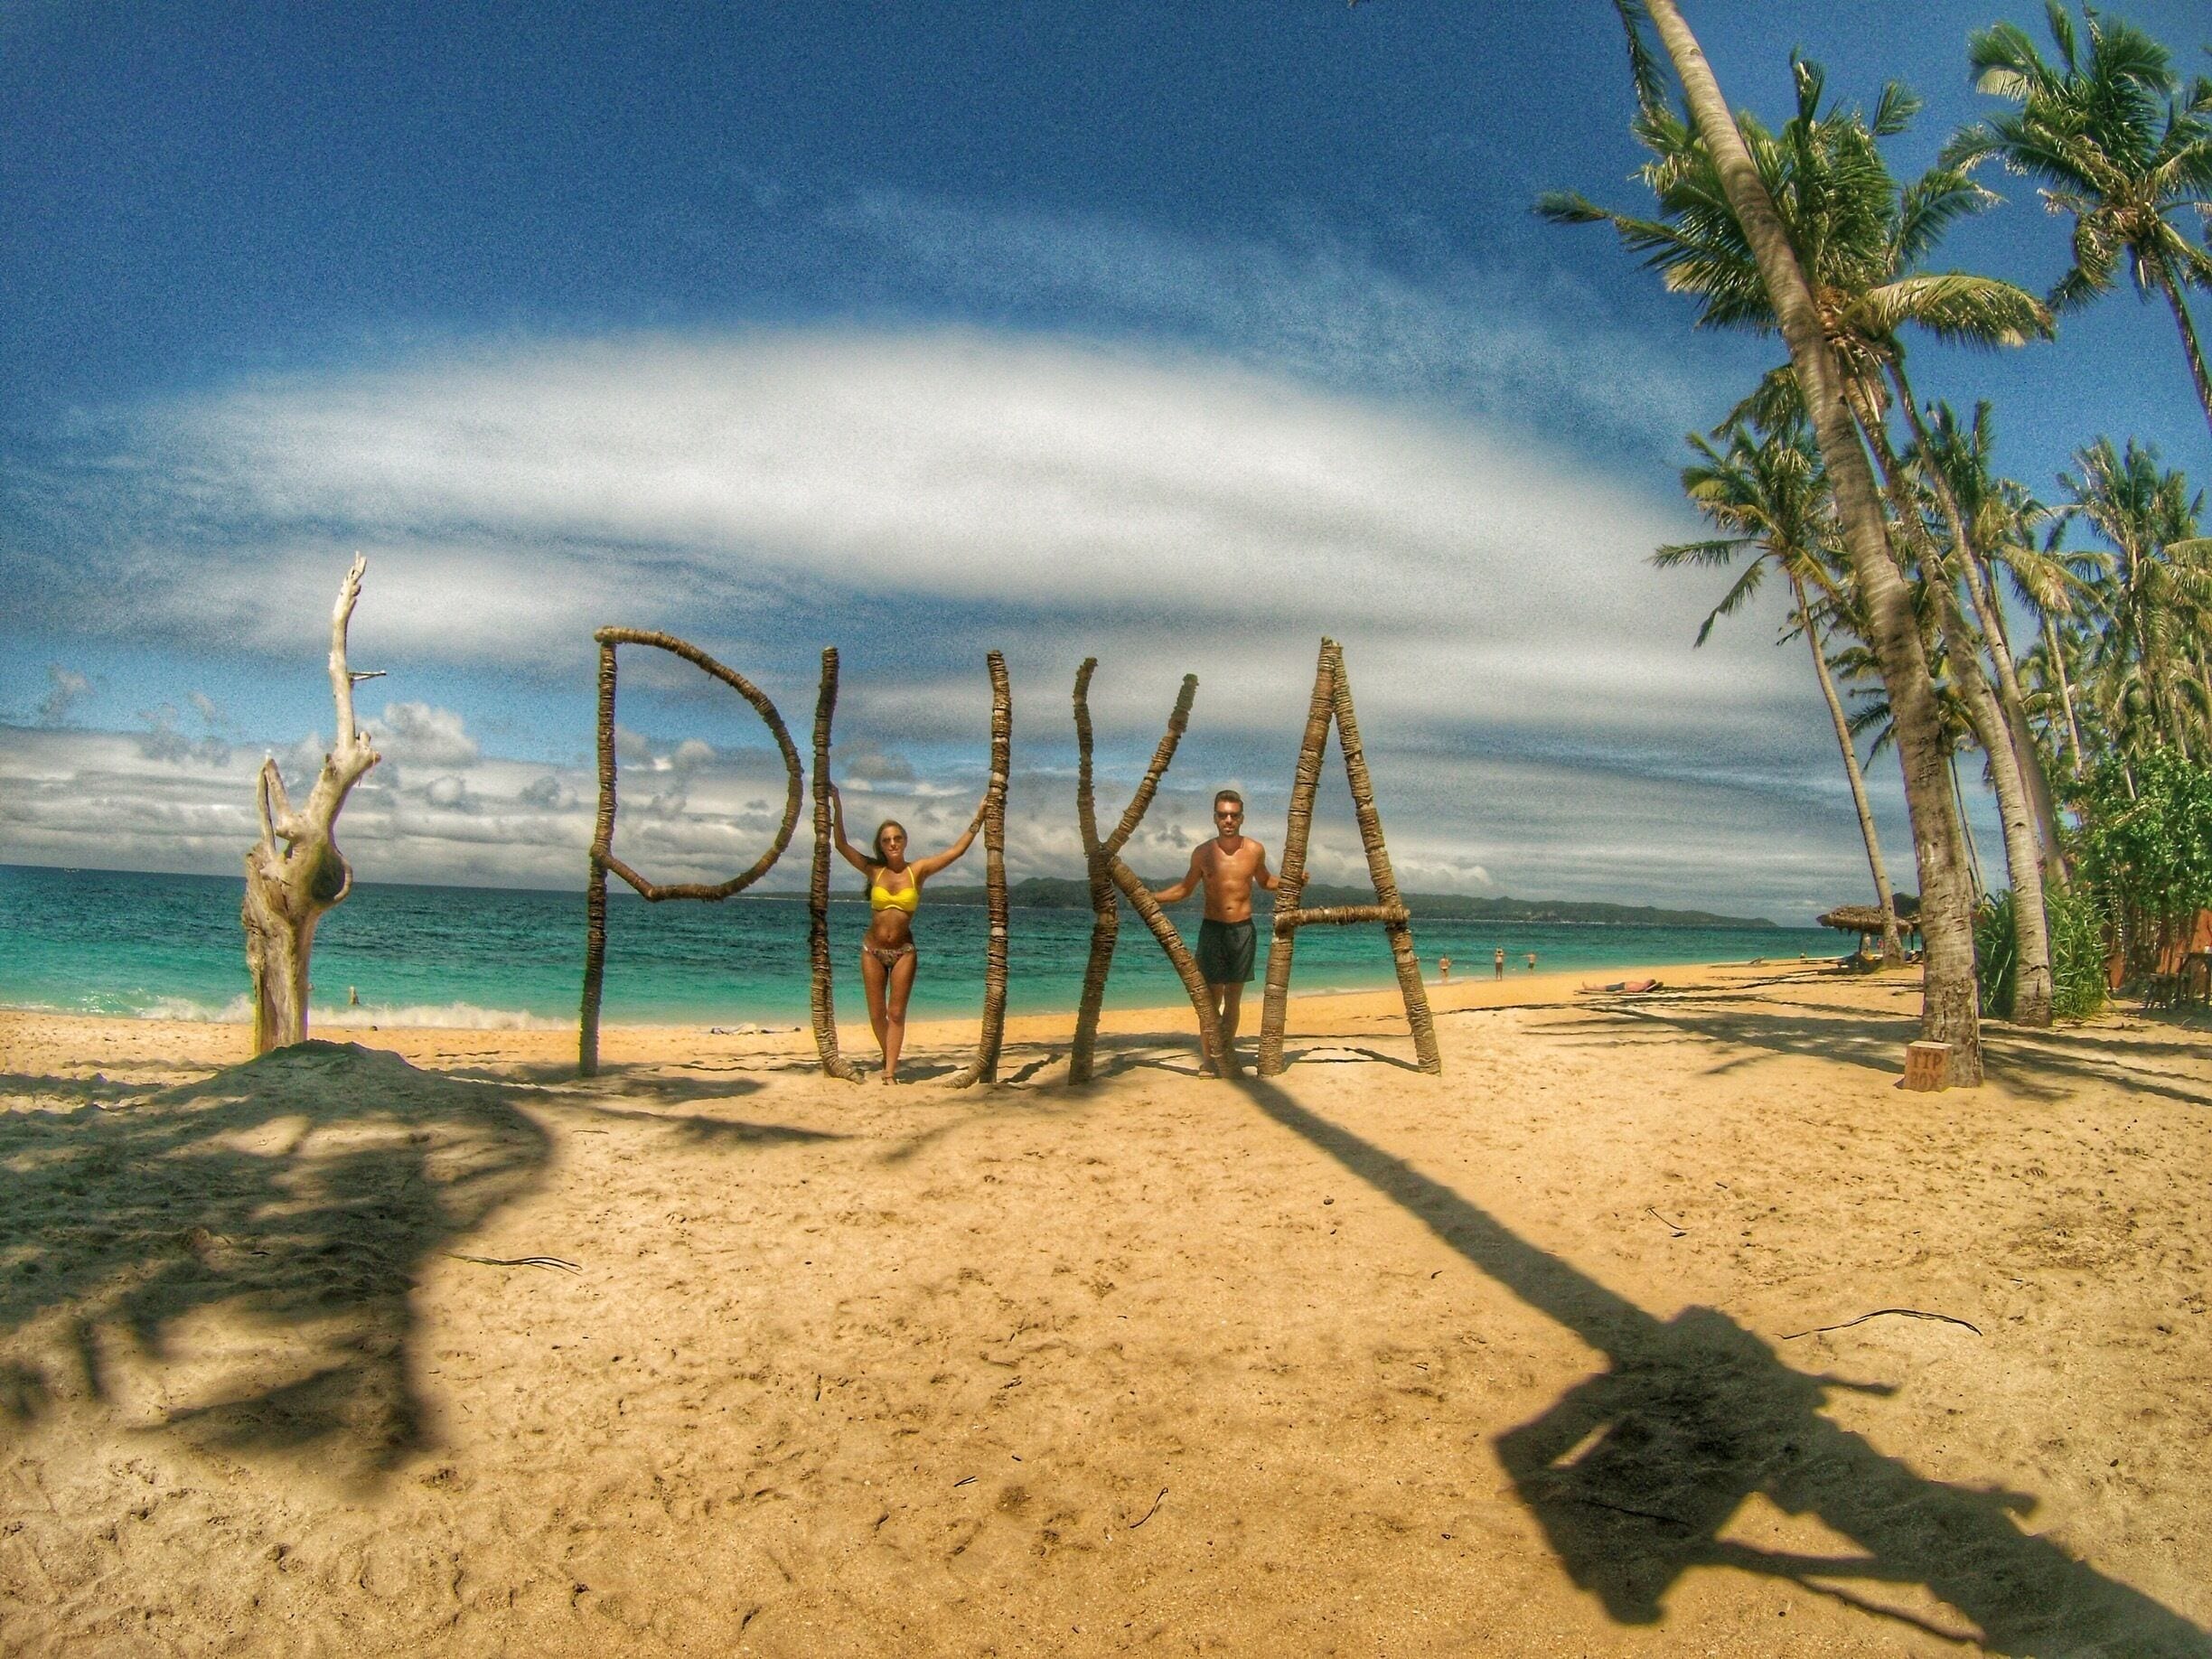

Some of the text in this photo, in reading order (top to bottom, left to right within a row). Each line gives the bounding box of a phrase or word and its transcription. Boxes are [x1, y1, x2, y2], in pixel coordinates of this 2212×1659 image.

[579, 626, 1443, 1088] PUKA
[1910, 1050, 1943, 1070] TIP
[1908, 1071, 1942, 1090] BOX
